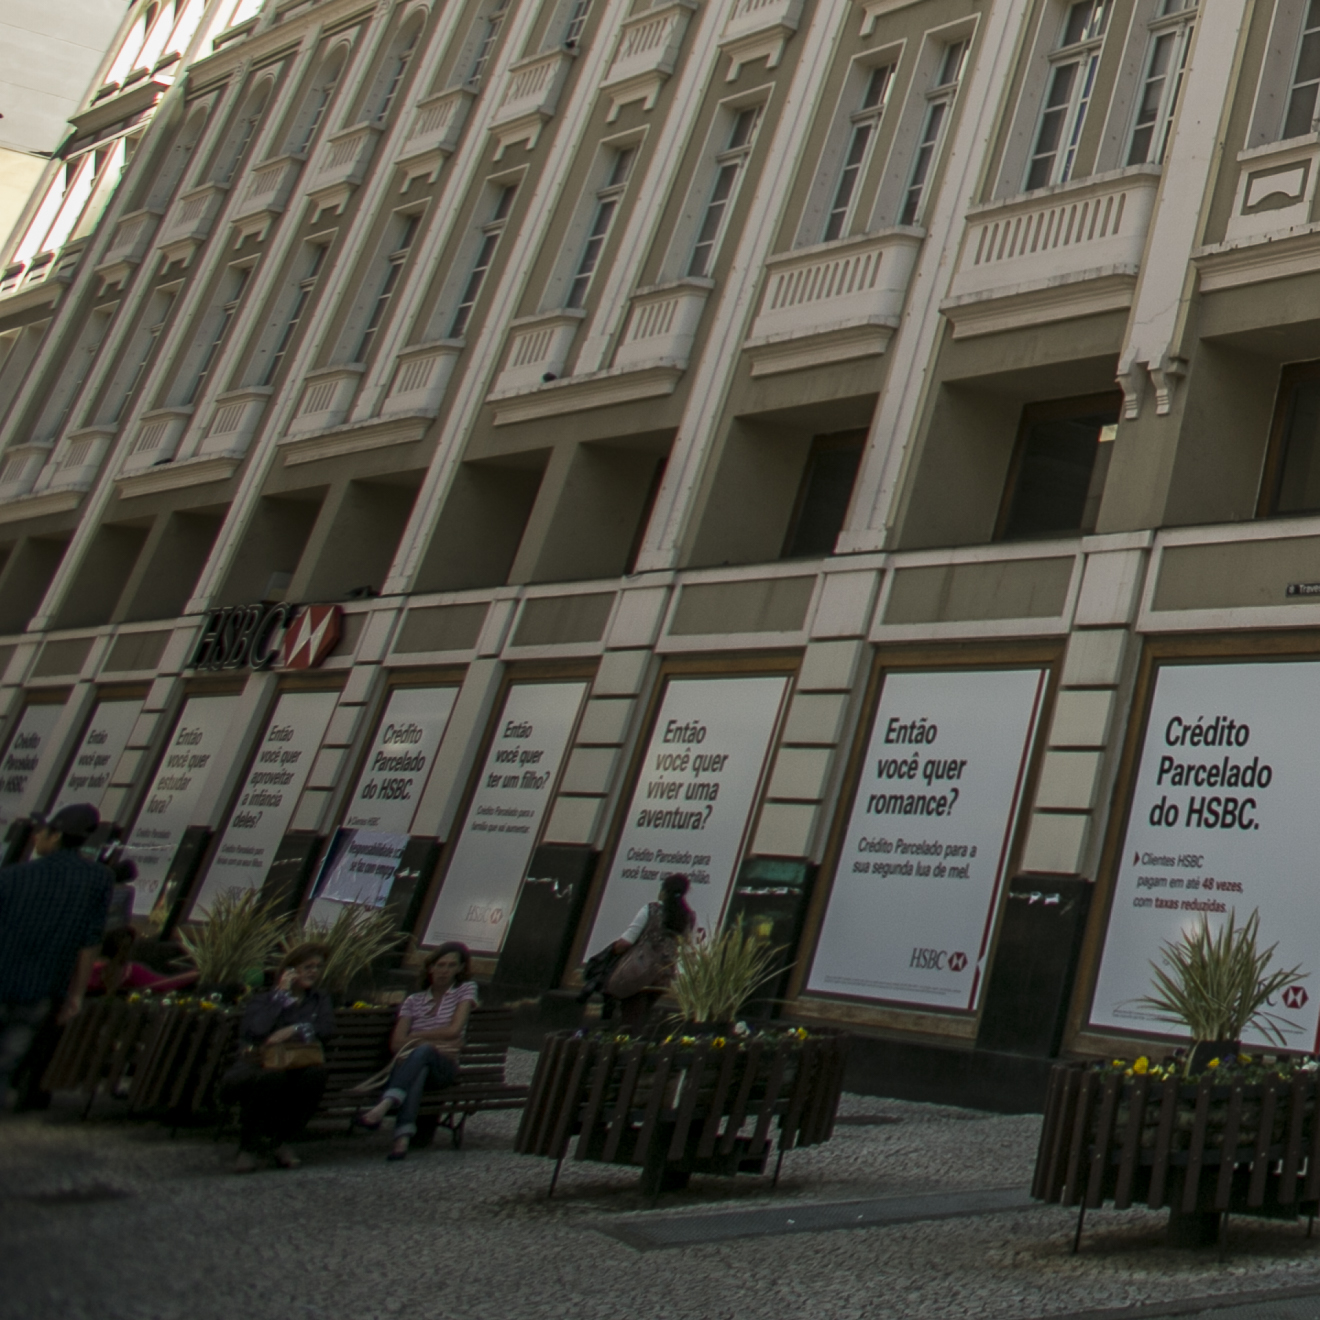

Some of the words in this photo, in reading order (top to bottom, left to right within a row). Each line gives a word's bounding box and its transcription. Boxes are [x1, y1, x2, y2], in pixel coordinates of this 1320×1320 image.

[186, 602, 290, 670] HSBC
[87, 729, 108, 745] Então
[175, 727, 203, 746] Então
[268, 724, 295, 742] Então
[383, 724, 423, 745] Crédito
[503, 721, 533, 738] Então
[662, 719, 707, 745] Então
[884, 717, 938, 745] Então
[1164, 714, 1251, 748] Crédito
[93, 754, 111, 769] quer
[167, 749, 188, 768] você
[187, 754, 211, 772] quer
[259, 746, 282, 764] você
[279, 750, 302, 767] quer
[371, 750, 426, 772] Parcelado
[495, 746, 520, 763] você
[518, 749, 544, 768] quer
[655, 747, 690, 772] você
[692, 753, 729, 778] quer
[250, 767, 295, 787] aproveitar
[877, 752, 919, 780] você
[922, 757, 968, 786] quer
[1156, 754, 1274, 789] Parcelado
[156, 773, 192, 790] estudar
[361, 778, 378, 799] do
[377, 778, 414, 801] HSBC.
[486, 772, 503, 789] ter
[501, 775, 520, 789] um
[519, 771, 551, 790] filho?
[646, 775, 684, 800] viver
[684, 782, 720, 801] uma
[147, 794, 173, 814] fora?
[241, 792, 250, 806] a
[248, 789, 283, 807] infância
[866, 787, 960, 817] romance?
[232, 811, 263, 828] deles?
[476, 805, 494, 816] Crédito
[495, 806, 518, 817] Parcelado
[637, 804, 713, 830] aventura?
[1149, 795, 1180, 827] do
[1184, 796, 1260, 831] HSBC.
[626, 847, 654, 862] Crédito
[654, 848, 693, 865] Parcelado
[691, 855, 711, 868] para
[857, 836, 893, 854] Crédito
[893, 838, 943, 857] Parcelado
[943, 843, 970, 861] para
[969, 845, 977, 858] a
[853, 861, 871, 875] sua
[871, 859, 913, 879] segunda
[914, 860, 931, 877] lua
[932, 860, 946, 877] de
[948, 862, 970, 879] mel.
[1141, 851, 1176, 868] Clientes
[1177, 853, 1204, 869] HSBC
[621, 865, 640, 879] você
[640, 865, 660, 881] fazer
[1136, 875, 1168, 891] pagam
[1168, 877, 1185, 889] em
[1185, 875, 1201, 890] até
[1201, 876, 1215, 890] 48
[1215, 879, 1244, 894] vezes,
[1133, 896, 1154, 909] com
[1154, 896, 1180, 911] taxas
[1180, 897, 1228, 913] reduzidas.
[909, 947, 948, 970] HSBC
